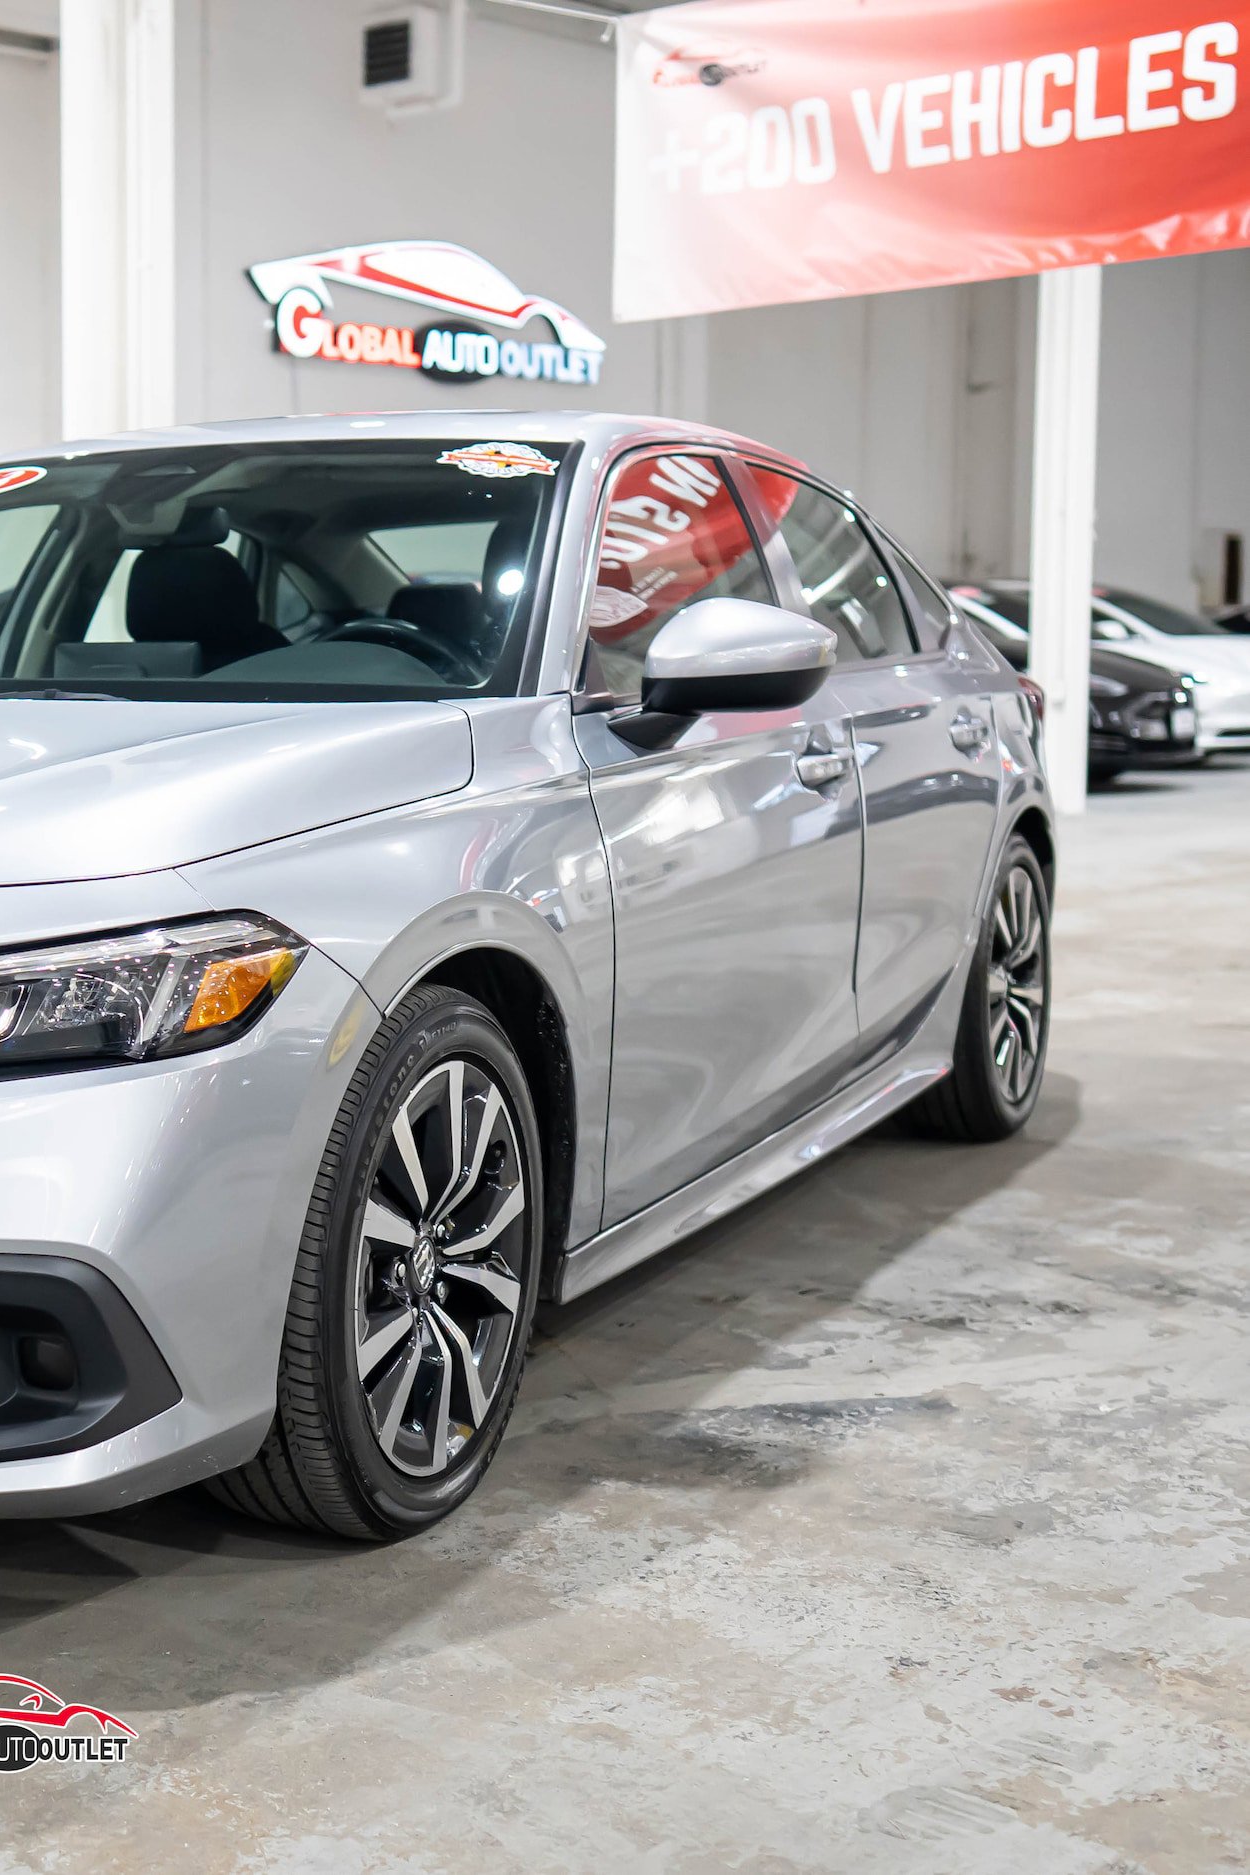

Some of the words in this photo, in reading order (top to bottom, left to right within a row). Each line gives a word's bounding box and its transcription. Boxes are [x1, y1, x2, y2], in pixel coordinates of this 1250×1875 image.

[650, 96, 837, 195] +200
[851, 21, 1239, 174] VEHICLES
[275, 286, 422, 369] GLOBAL
[421, 329, 500, 376] AUTO
[499, 341, 603, 385] OUTLET
